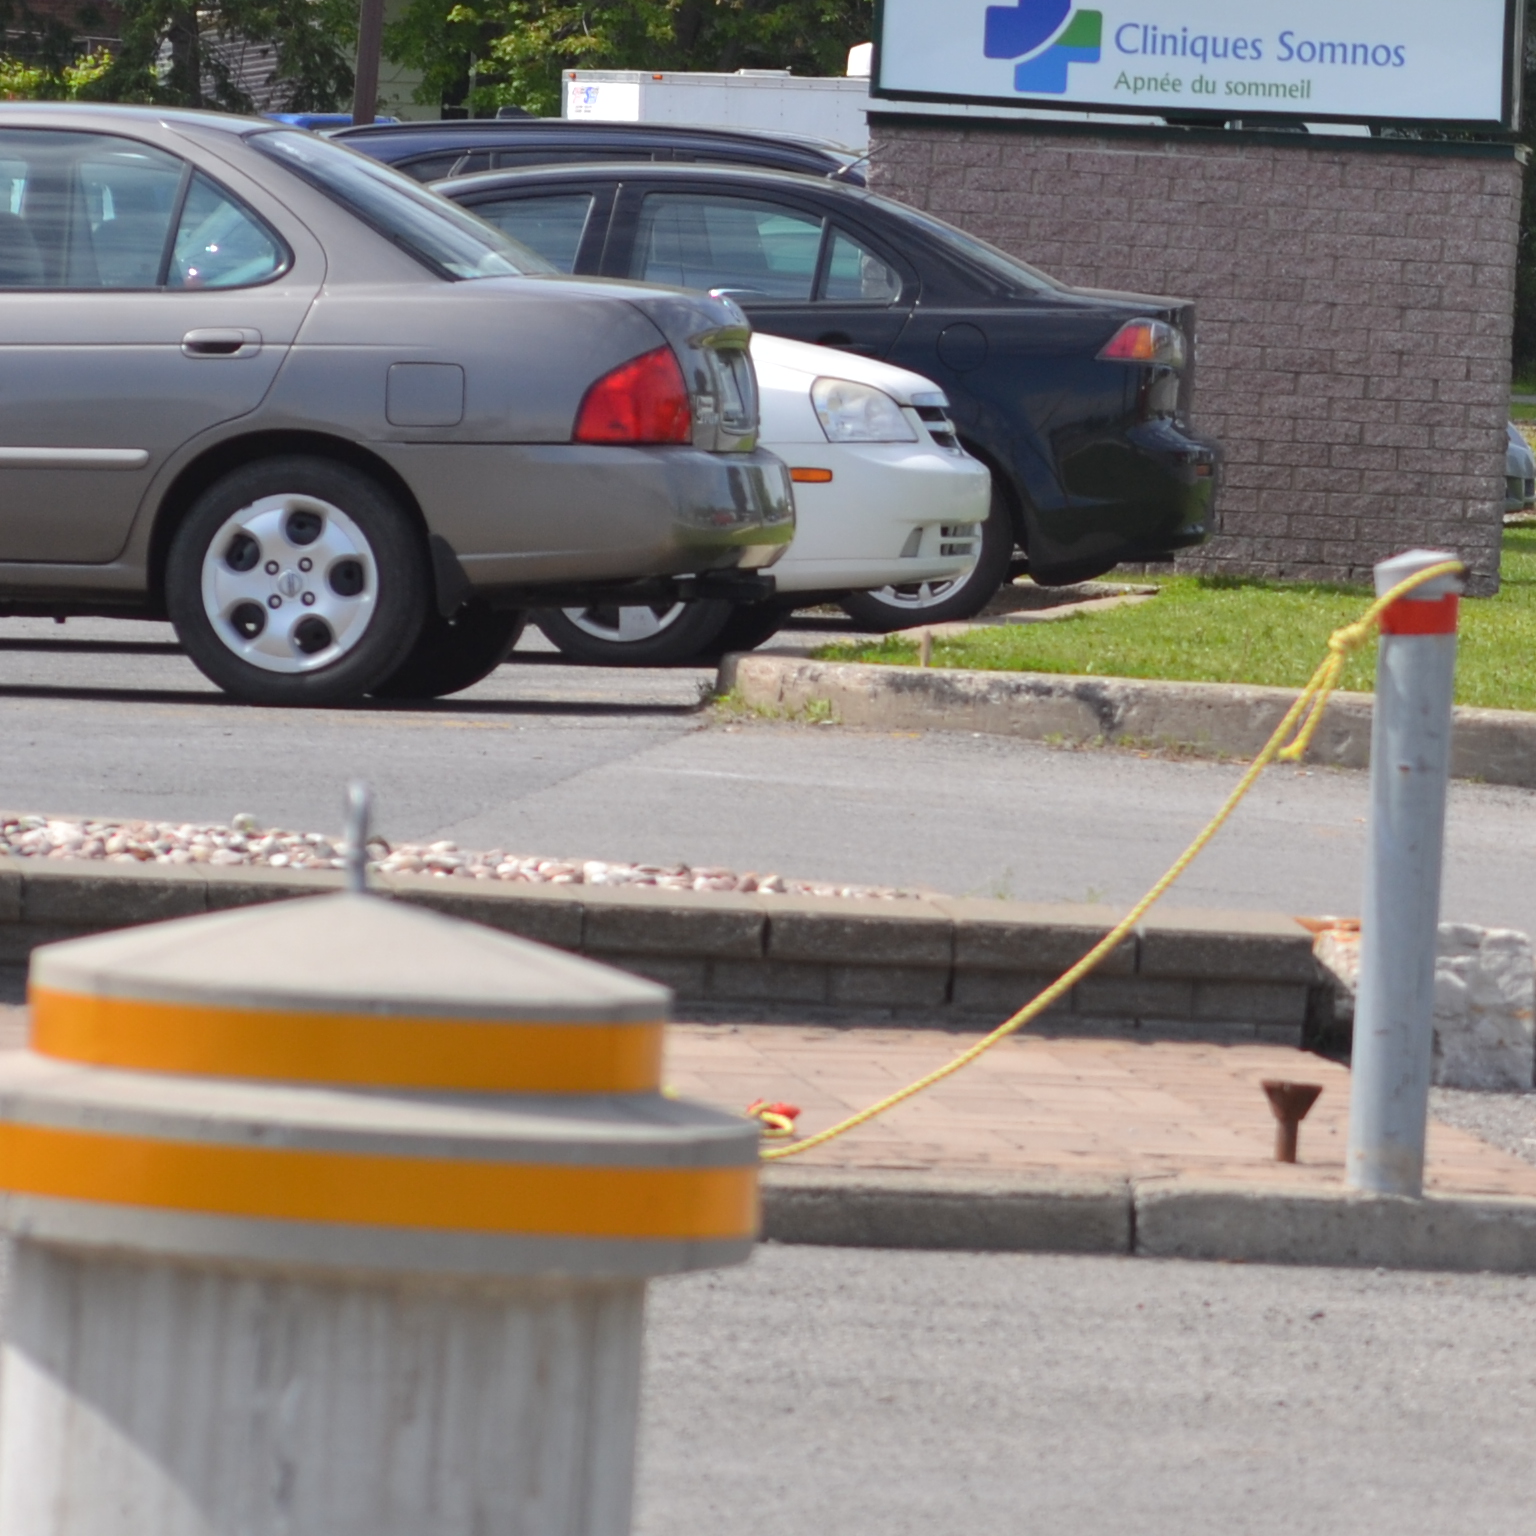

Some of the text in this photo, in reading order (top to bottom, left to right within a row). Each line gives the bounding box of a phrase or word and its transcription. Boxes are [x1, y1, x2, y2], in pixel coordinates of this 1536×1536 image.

[1113, 22, 1406, 68] Cliniques Somnos
[1113, 70, 1312, 100] Apnée du sommeil
